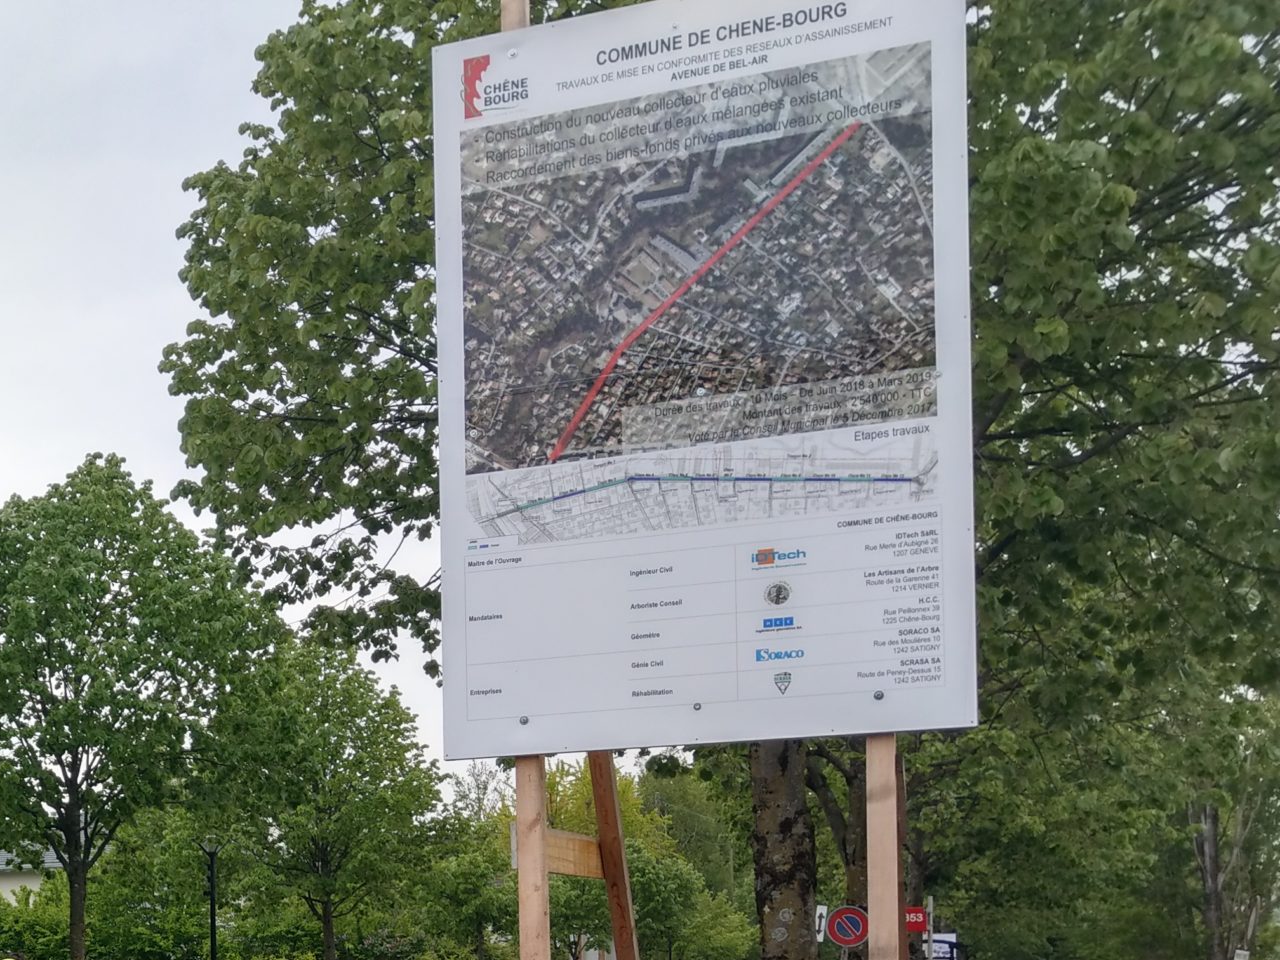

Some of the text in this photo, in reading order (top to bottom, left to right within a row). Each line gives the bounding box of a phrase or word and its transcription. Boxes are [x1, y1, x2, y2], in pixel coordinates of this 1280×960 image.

[596, 2, 848, 66] COMMUNE DE CHENE-BOURG
[556, 16, 893, 92] TRAVAUX DE MISE EN CONFORMITE DES RESEAUX D'ASSAINISSEMENT
[670, 54, 768, 82] AVENUE DE BEL-AIR
[483, 78, 528, 96] CHÊNE
[484, 89, 529, 107] BOURG
[485, 70, 818, 144] Construction du nouveau collecteur d'eaux pluviales
[486, 85, 844, 164] Réhabilitations du collecteur d'eaux mélangées existant
[486, 100, 902, 184] Raccordement des biens-fonds privés aux nouveaux collecteurs
[654, 405, 683, 418] Durée
[686, 402, 703, 413] des
[706, 399, 740, 411] travaux
[765, 392, 787, 402] Mois
[800, 388, 813, 398] De
[817, 386, 837, 396] Juin
[840, 381, 864, 393] 2018
[877, 376, 902, 388] Mars
[906, 371, 931, 384] 2019
[742, 407, 783, 420] Montant
[785, 404, 802, 415] des
[805, 400, 841, 412] travaux
[910, 387, 932, 399] TTC
[689, 429, 710, 443] Voté
[712, 429, 728, 442] par
[742, 422, 779, 436] Conseil
[781, 415, 827, 433] Municipal
[851, 407, 903, 422] Décembre
[907, 402, 933, 415] 2017
[854, 424, 930, 442] Etapes travaux
[837, 511, 938, 529] COMMUNE DE CHÊNE-BOURG
[864, 544, 878, 552] Rue
[486, 558, 494, 566] de
[495, 556, 522, 566] l'Ouvrage
[629, 566, 673, 578] Ingénieur Civil
[877, 568, 905, 577] Artisans
[916, 565, 940, 573] l'Arbre
[908, 581, 940, 591] VERNIER
[630, 599, 683, 611] Arboriste Conseil
[468, 612, 503, 622] Mandataires
[898, 614, 940, 624] Chêne-Bourg
[898, 626, 940, 637] SORACO SA
[873, 639, 886, 647] Rue
[910, 644, 941, 653] SATIGNY
[756, 648, 805, 661] SORACO
[650, 660, 664, 668] Civil
[900, 658, 929, 667] SCRASA
[856, 671, 876, 679] Route
[910, 674, 941, 684] SATIGNY
[470, 687, 502, 697] Entreprises
[631, 688, 674, 698] Réhabilitation
